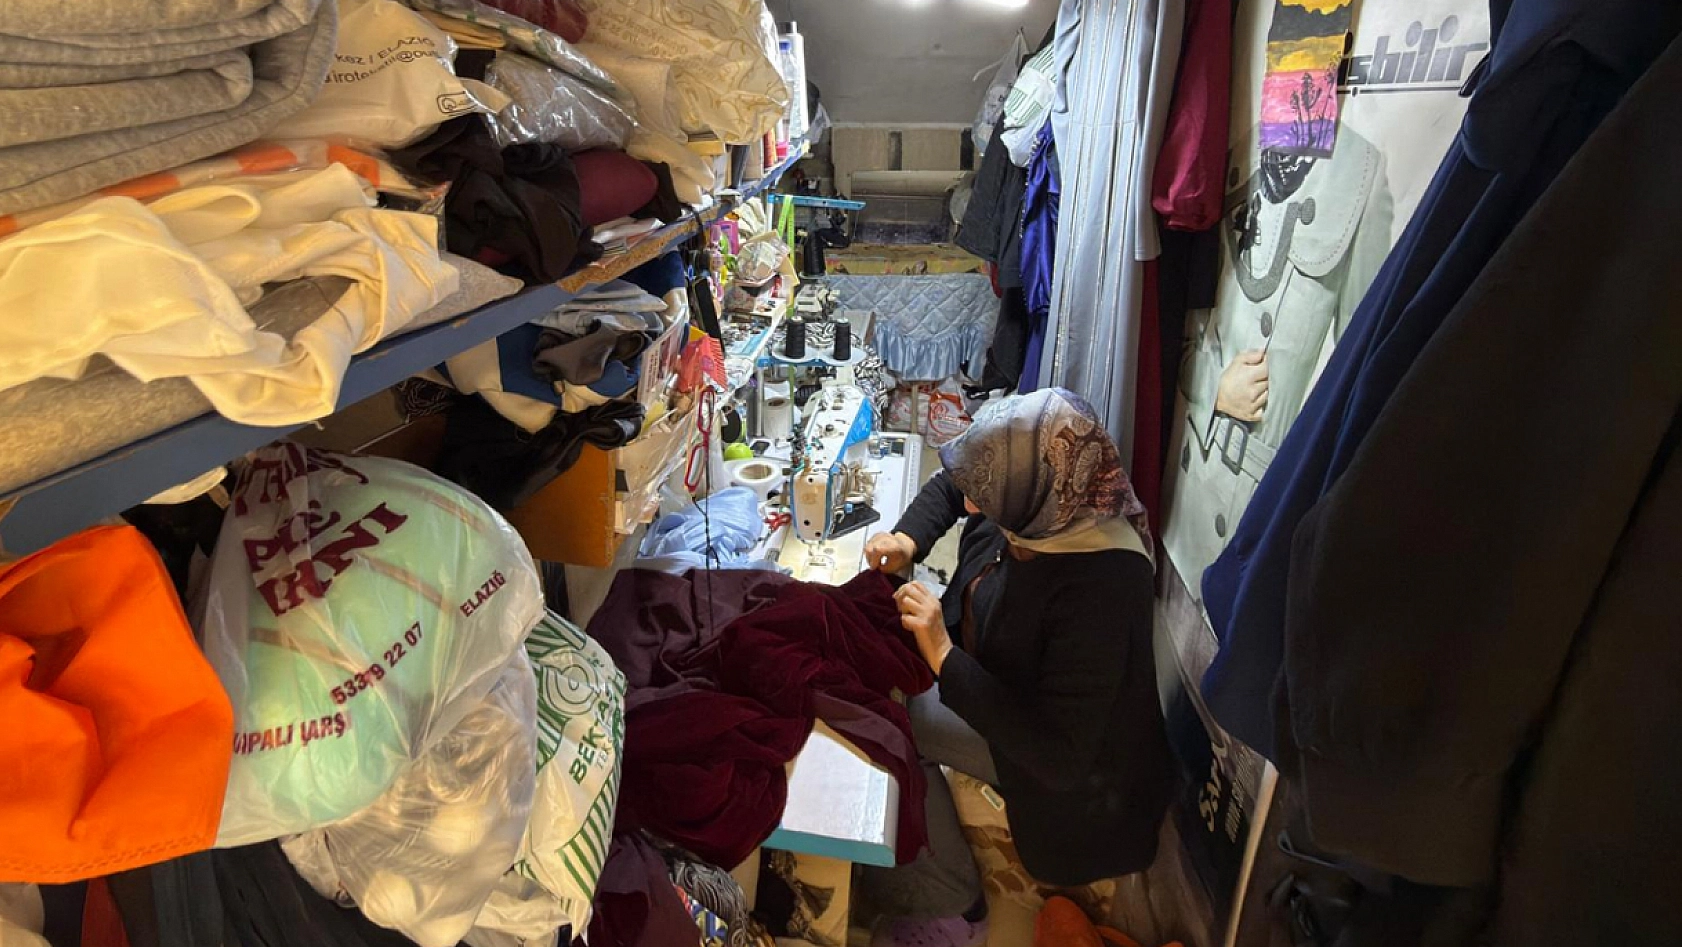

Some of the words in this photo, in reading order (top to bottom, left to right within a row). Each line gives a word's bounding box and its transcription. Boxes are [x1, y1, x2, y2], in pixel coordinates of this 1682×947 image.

[460, 570, 507, 617] ELAZIĞ
[384, 642, 407, 668] 22
[404, 621, 424, 647] 07
